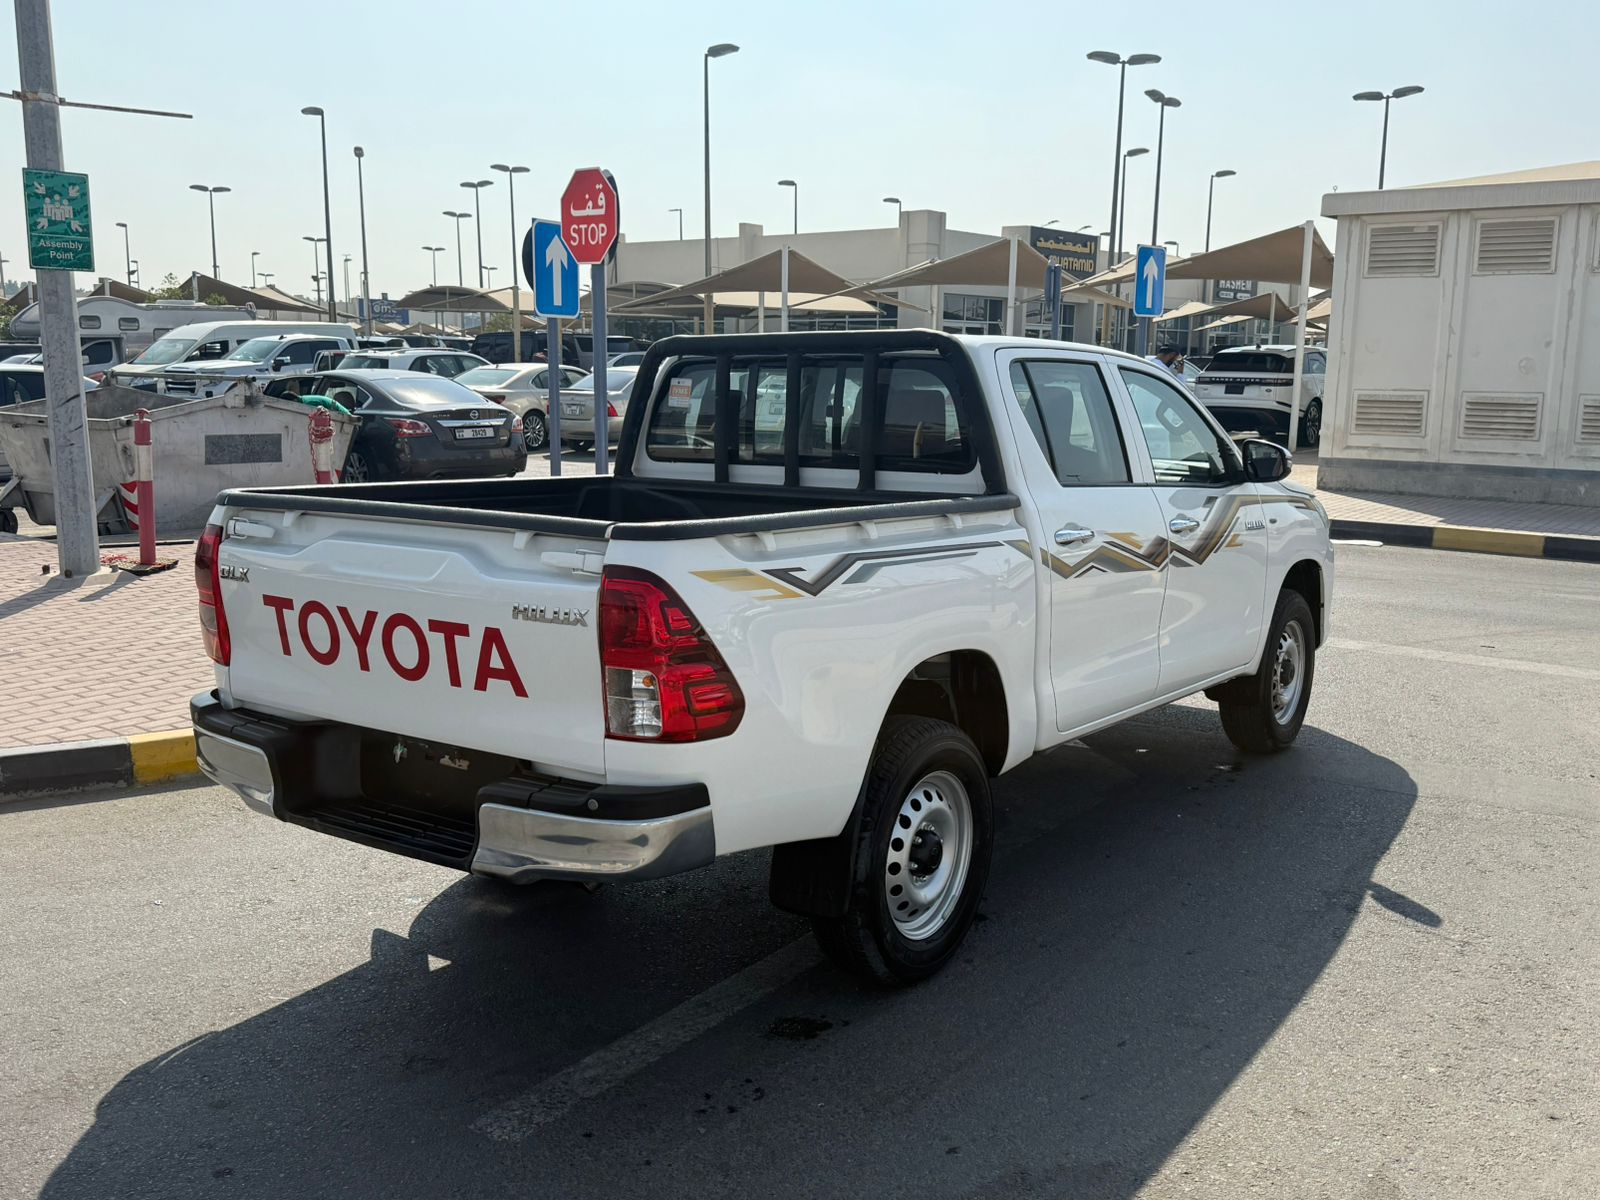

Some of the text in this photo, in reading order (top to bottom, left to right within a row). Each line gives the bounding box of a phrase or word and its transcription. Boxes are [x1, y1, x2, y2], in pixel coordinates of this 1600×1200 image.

[570, 183, 606, 217] قف
[38, 238, 83, 251] Assembly
[570, 223, 608, 246] STOP
[49, 250, 74, 260] Point
[220, 564, 250, 583] GLX
[511, 601, 590, 627] HILUX
[262, 594, 529, 699] TOYOTA
